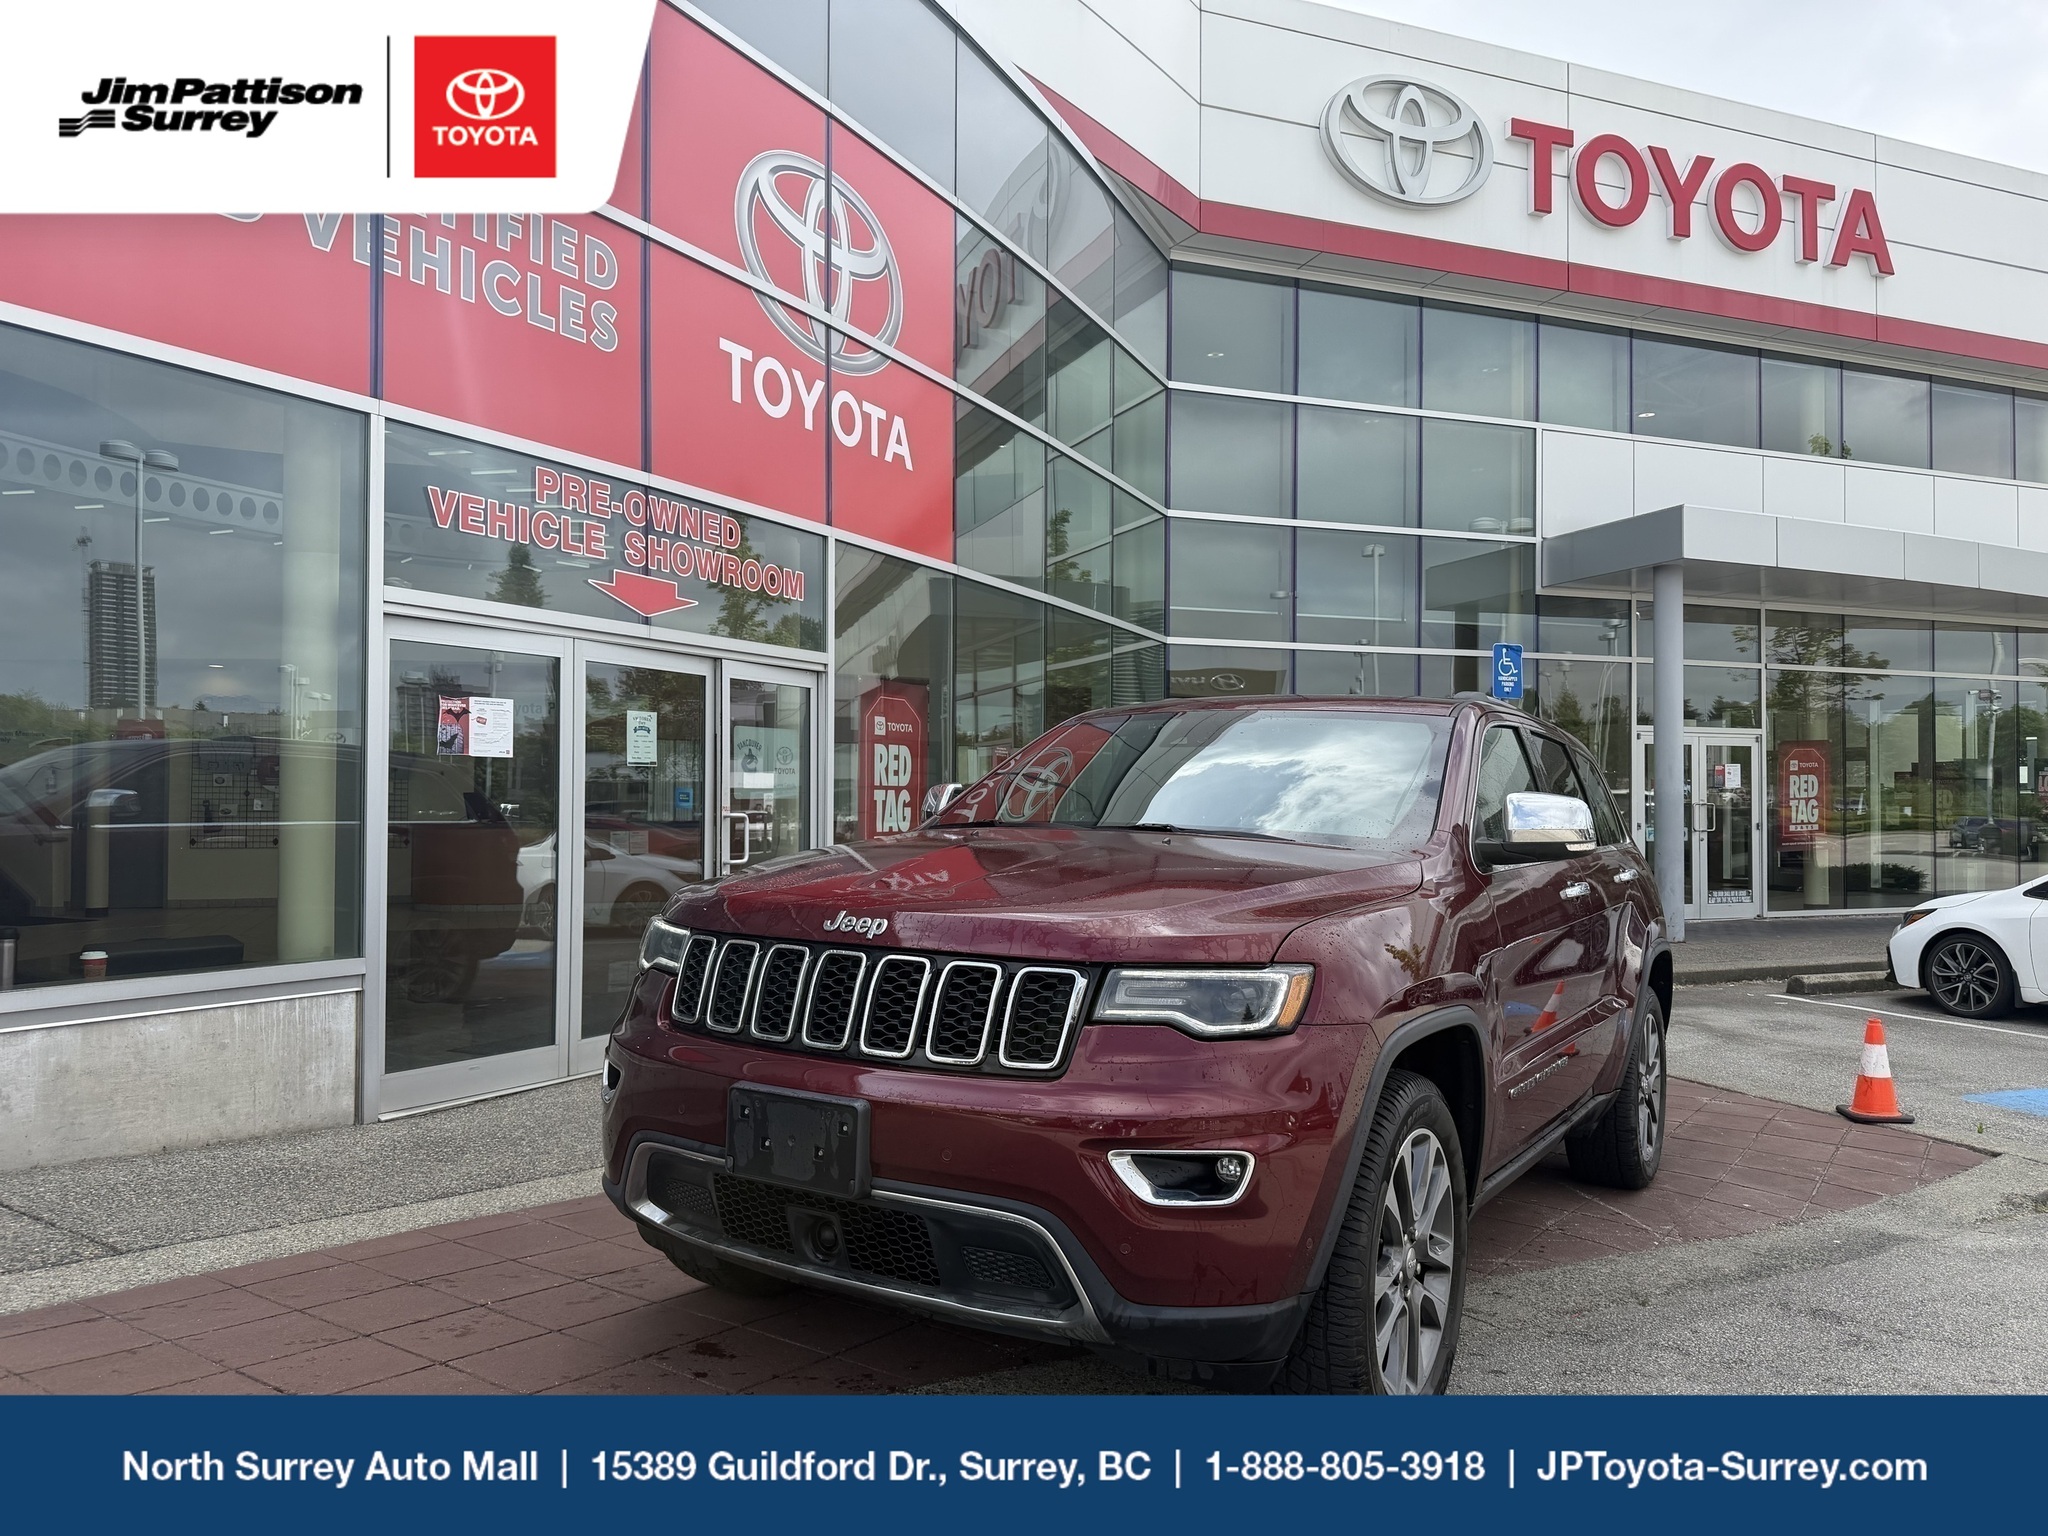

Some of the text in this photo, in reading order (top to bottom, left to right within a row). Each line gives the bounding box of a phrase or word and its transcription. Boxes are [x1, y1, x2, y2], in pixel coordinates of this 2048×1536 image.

[1505, 117, 1895, 278] TOYOTA
[302, 213, 618, 352] VEHICLES
[719, 337, 914, 472] TOYOTA
[535, 466, 742, 550] PRE-OWNED
[427, 486, 804, 602] VEHICLE SHOWROOM
[737, 739, 763, 753] VANCOUVER
[887, 722, 913, 733] TOYOTA
[774, 767, 796, 775] TOYOTA
[874, 743, 912, 787] RED
[1789, 774, 1819, 799] RED
[873, 789, 912, 833] TAG
[1789, 799, 1819, 824] TAG
[823, 910, 890, 939] Jeep
